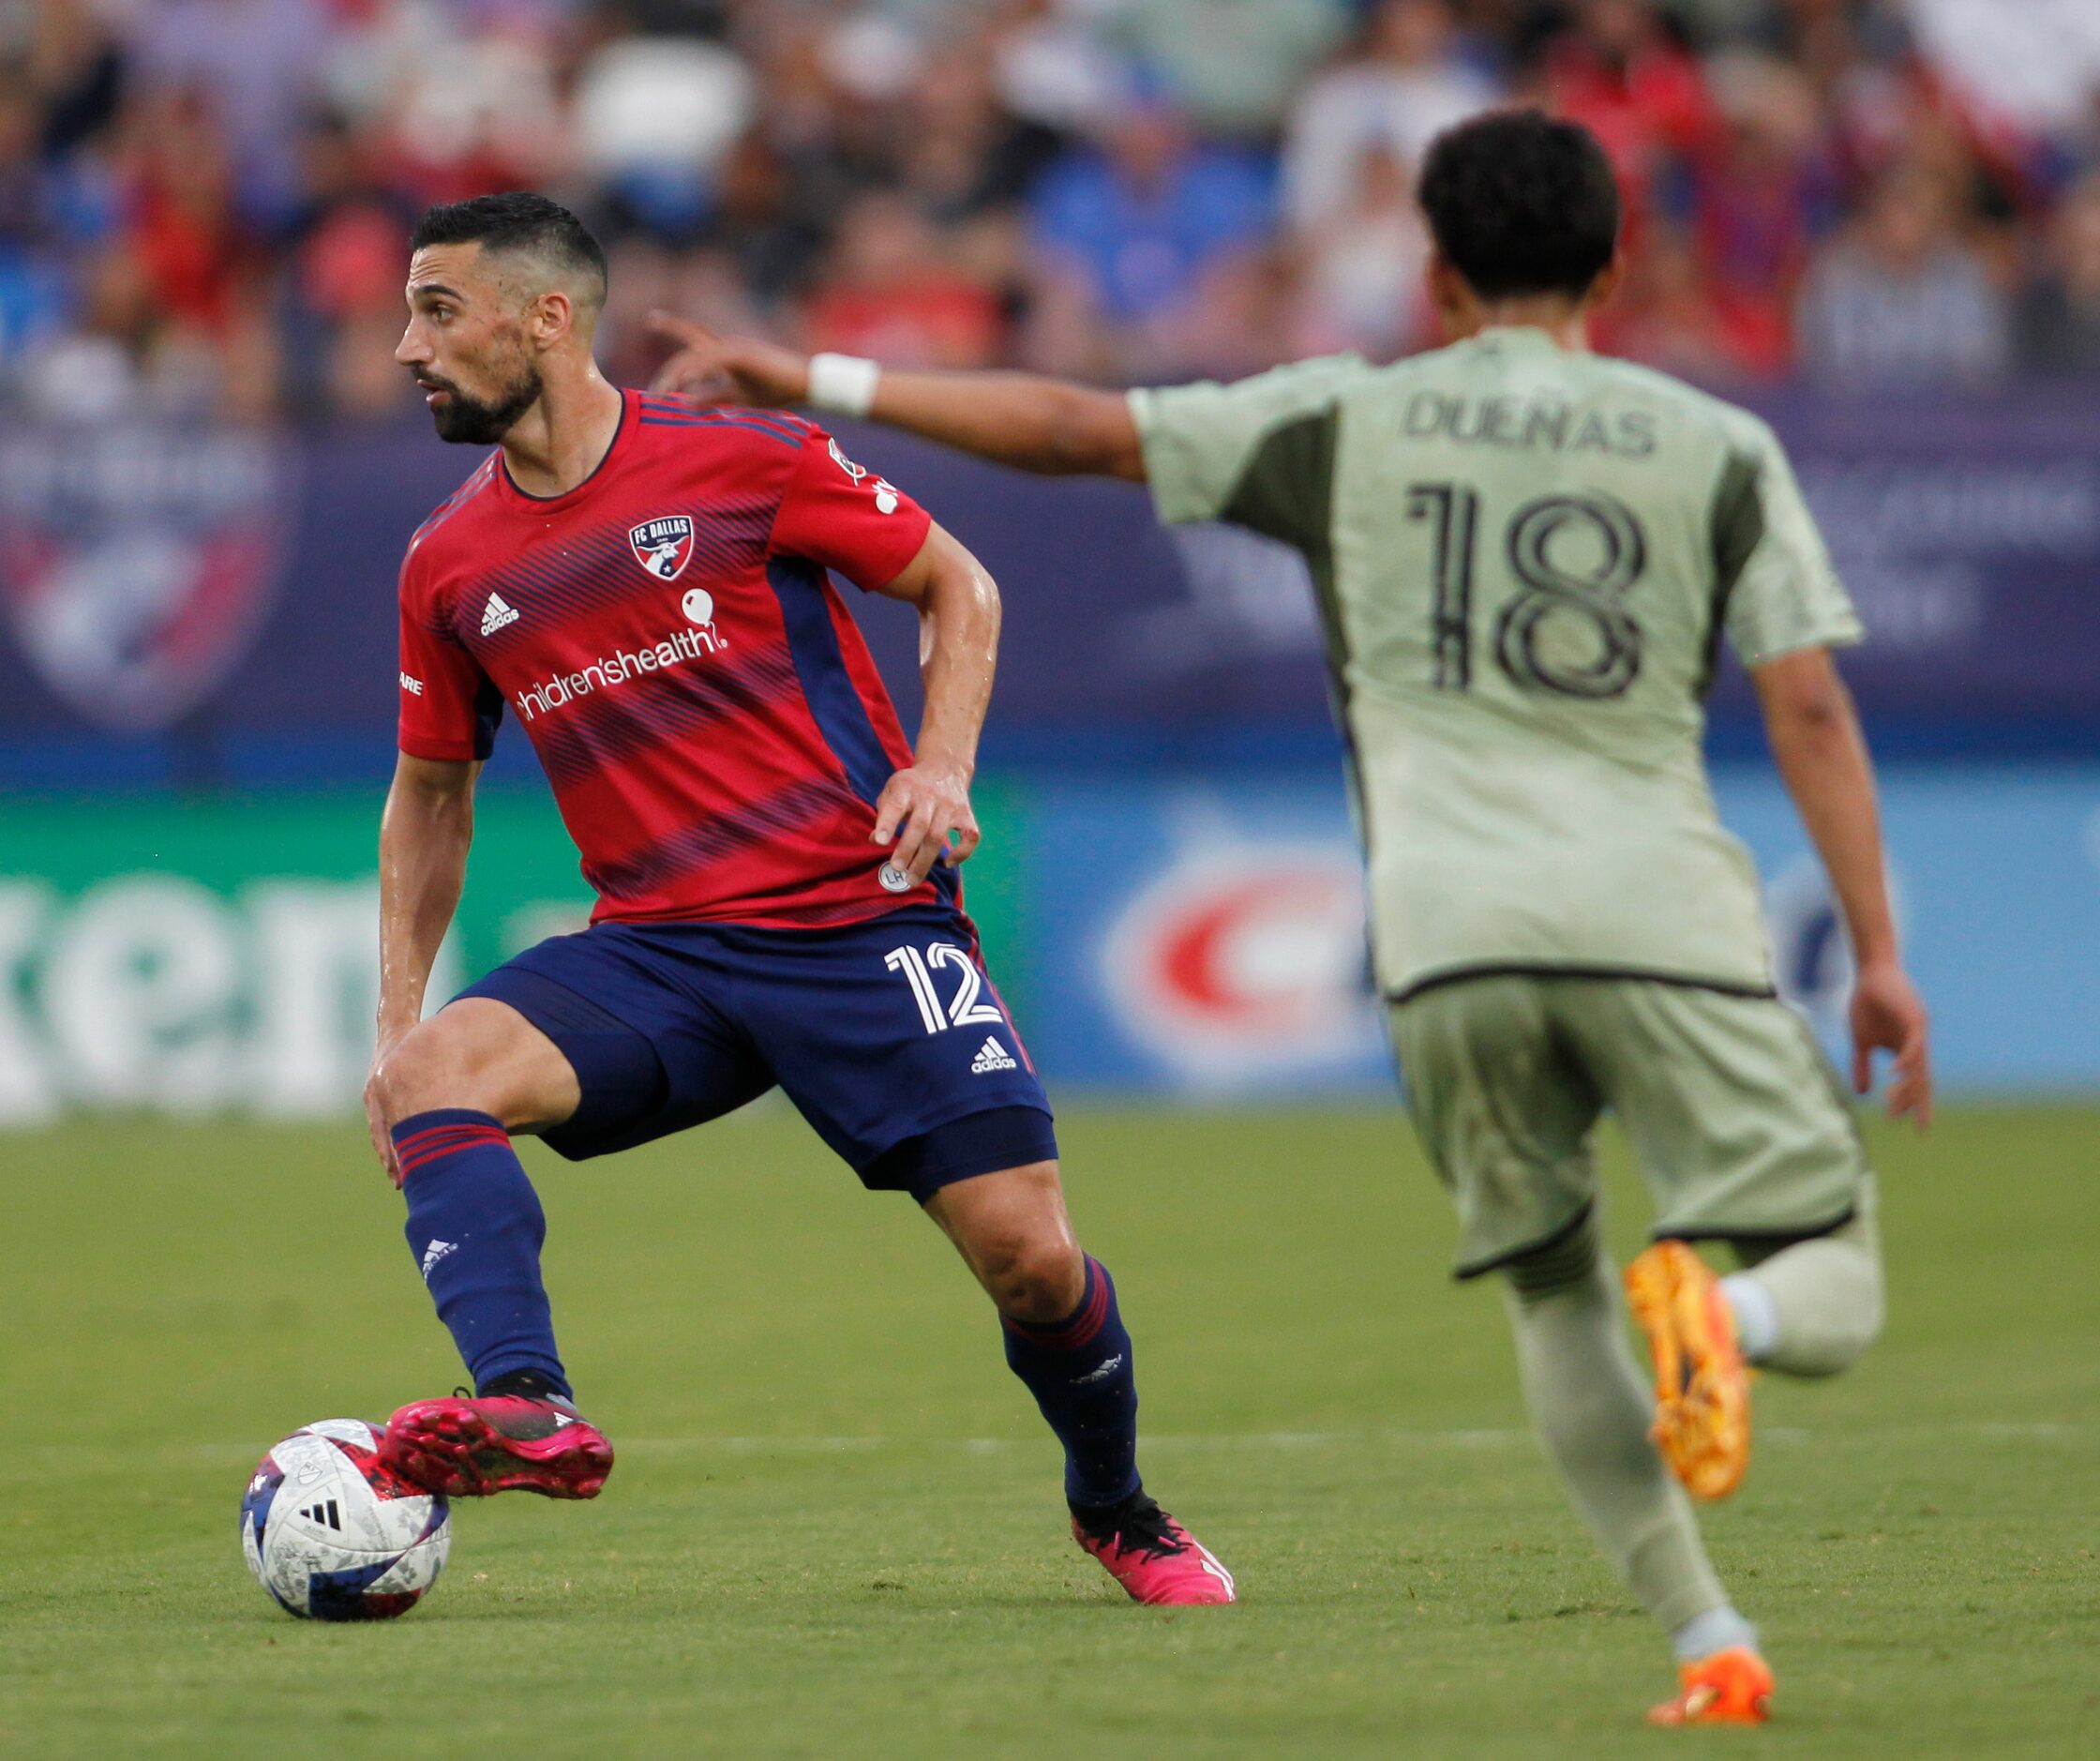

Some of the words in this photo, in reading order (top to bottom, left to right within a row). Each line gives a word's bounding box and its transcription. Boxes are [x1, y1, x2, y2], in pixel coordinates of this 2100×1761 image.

[1406, 389, 1655, 458] DUEÑAS
[634, 527, 647, 545] FC
[649, 519, 688, 538] DALLAS
[1405, 483, 1647, 699] 18
[481, 609, 519, 636] adidas
[884, 942, 1003, 1034] 12
[971, 1056, 1016, 1074] adidas
